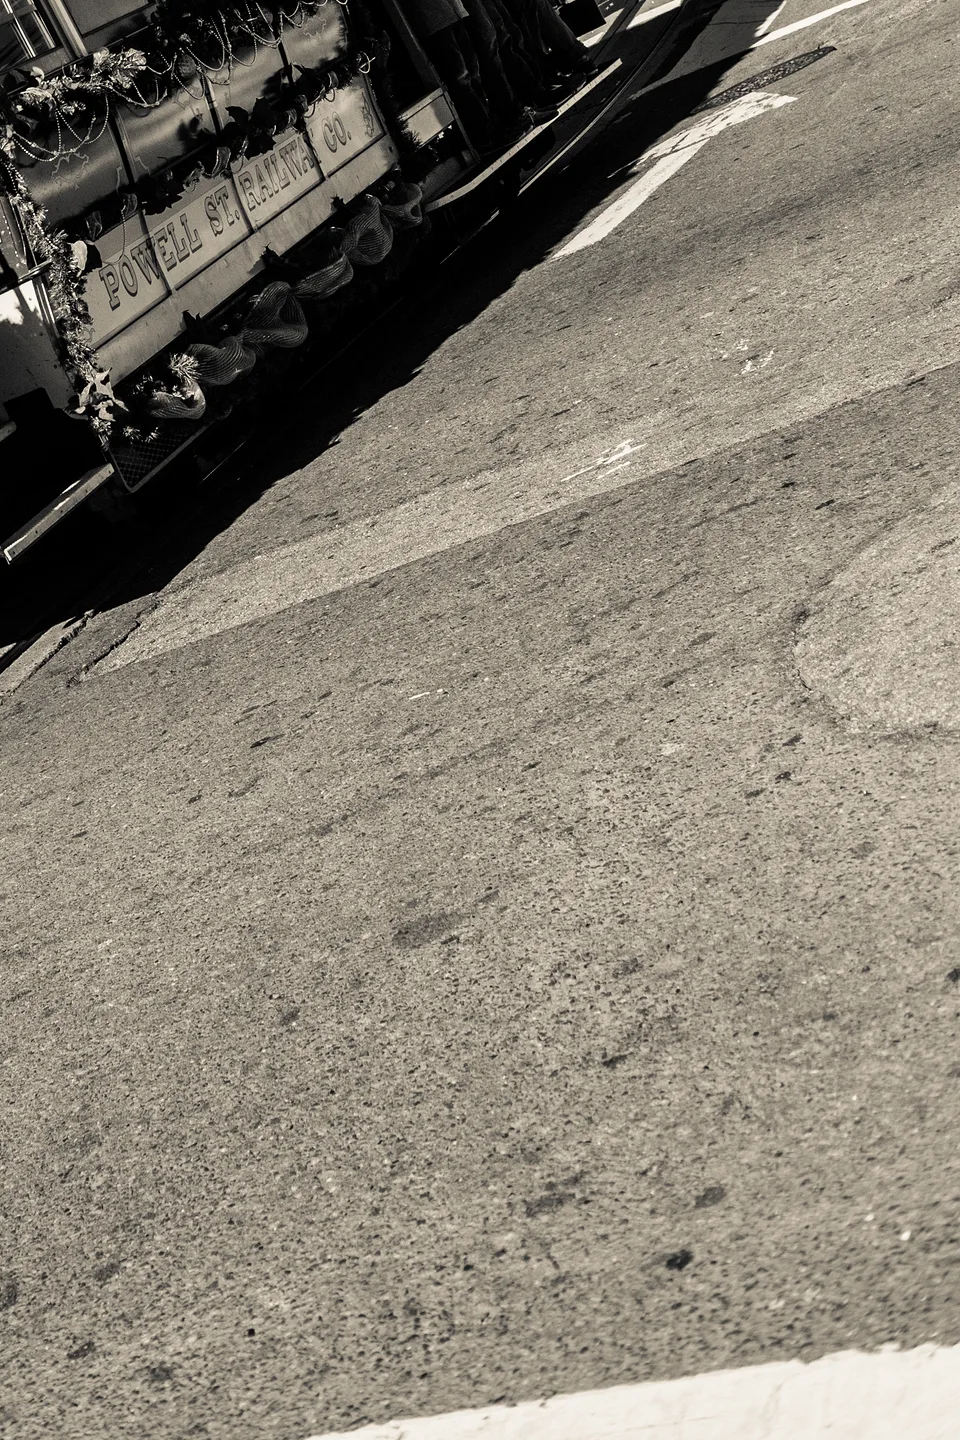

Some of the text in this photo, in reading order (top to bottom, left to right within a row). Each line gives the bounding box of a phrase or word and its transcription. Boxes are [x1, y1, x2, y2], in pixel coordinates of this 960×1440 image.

[98, 215, 202, 311] POWELL
[203, 185, 241, 238] ST.
[321, 111, 353, 154] CO.
